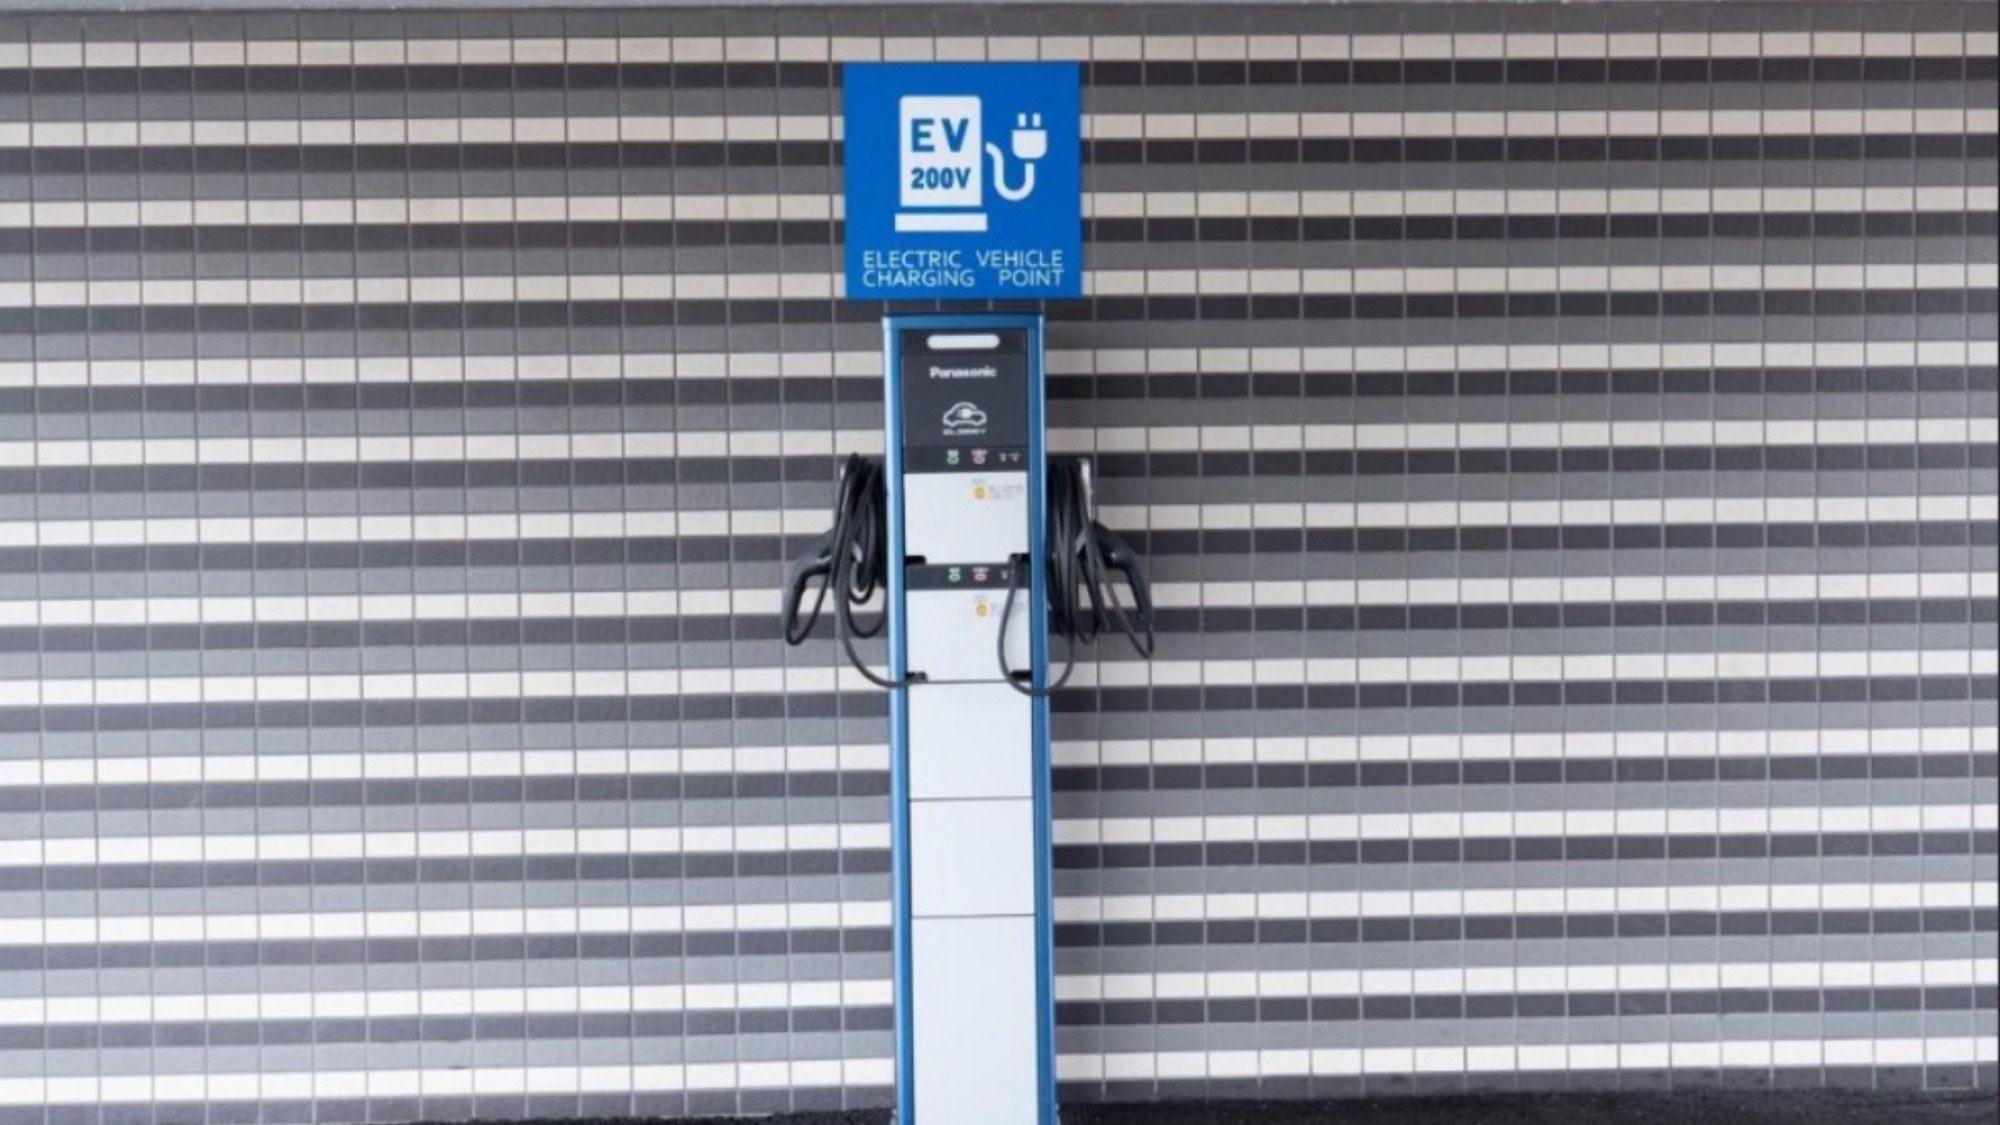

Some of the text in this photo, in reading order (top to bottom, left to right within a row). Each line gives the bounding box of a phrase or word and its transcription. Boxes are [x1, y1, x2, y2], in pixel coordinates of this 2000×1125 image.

[911, 118, 969, 153] EV
[911, 167, 971, 190] 200V
[863, 250, 1063, 269] ELECTRIC VEHICLE
[863, 269, 1065, 287] CHARGING POINT
[929, 366, 997, 379] Panasonic
